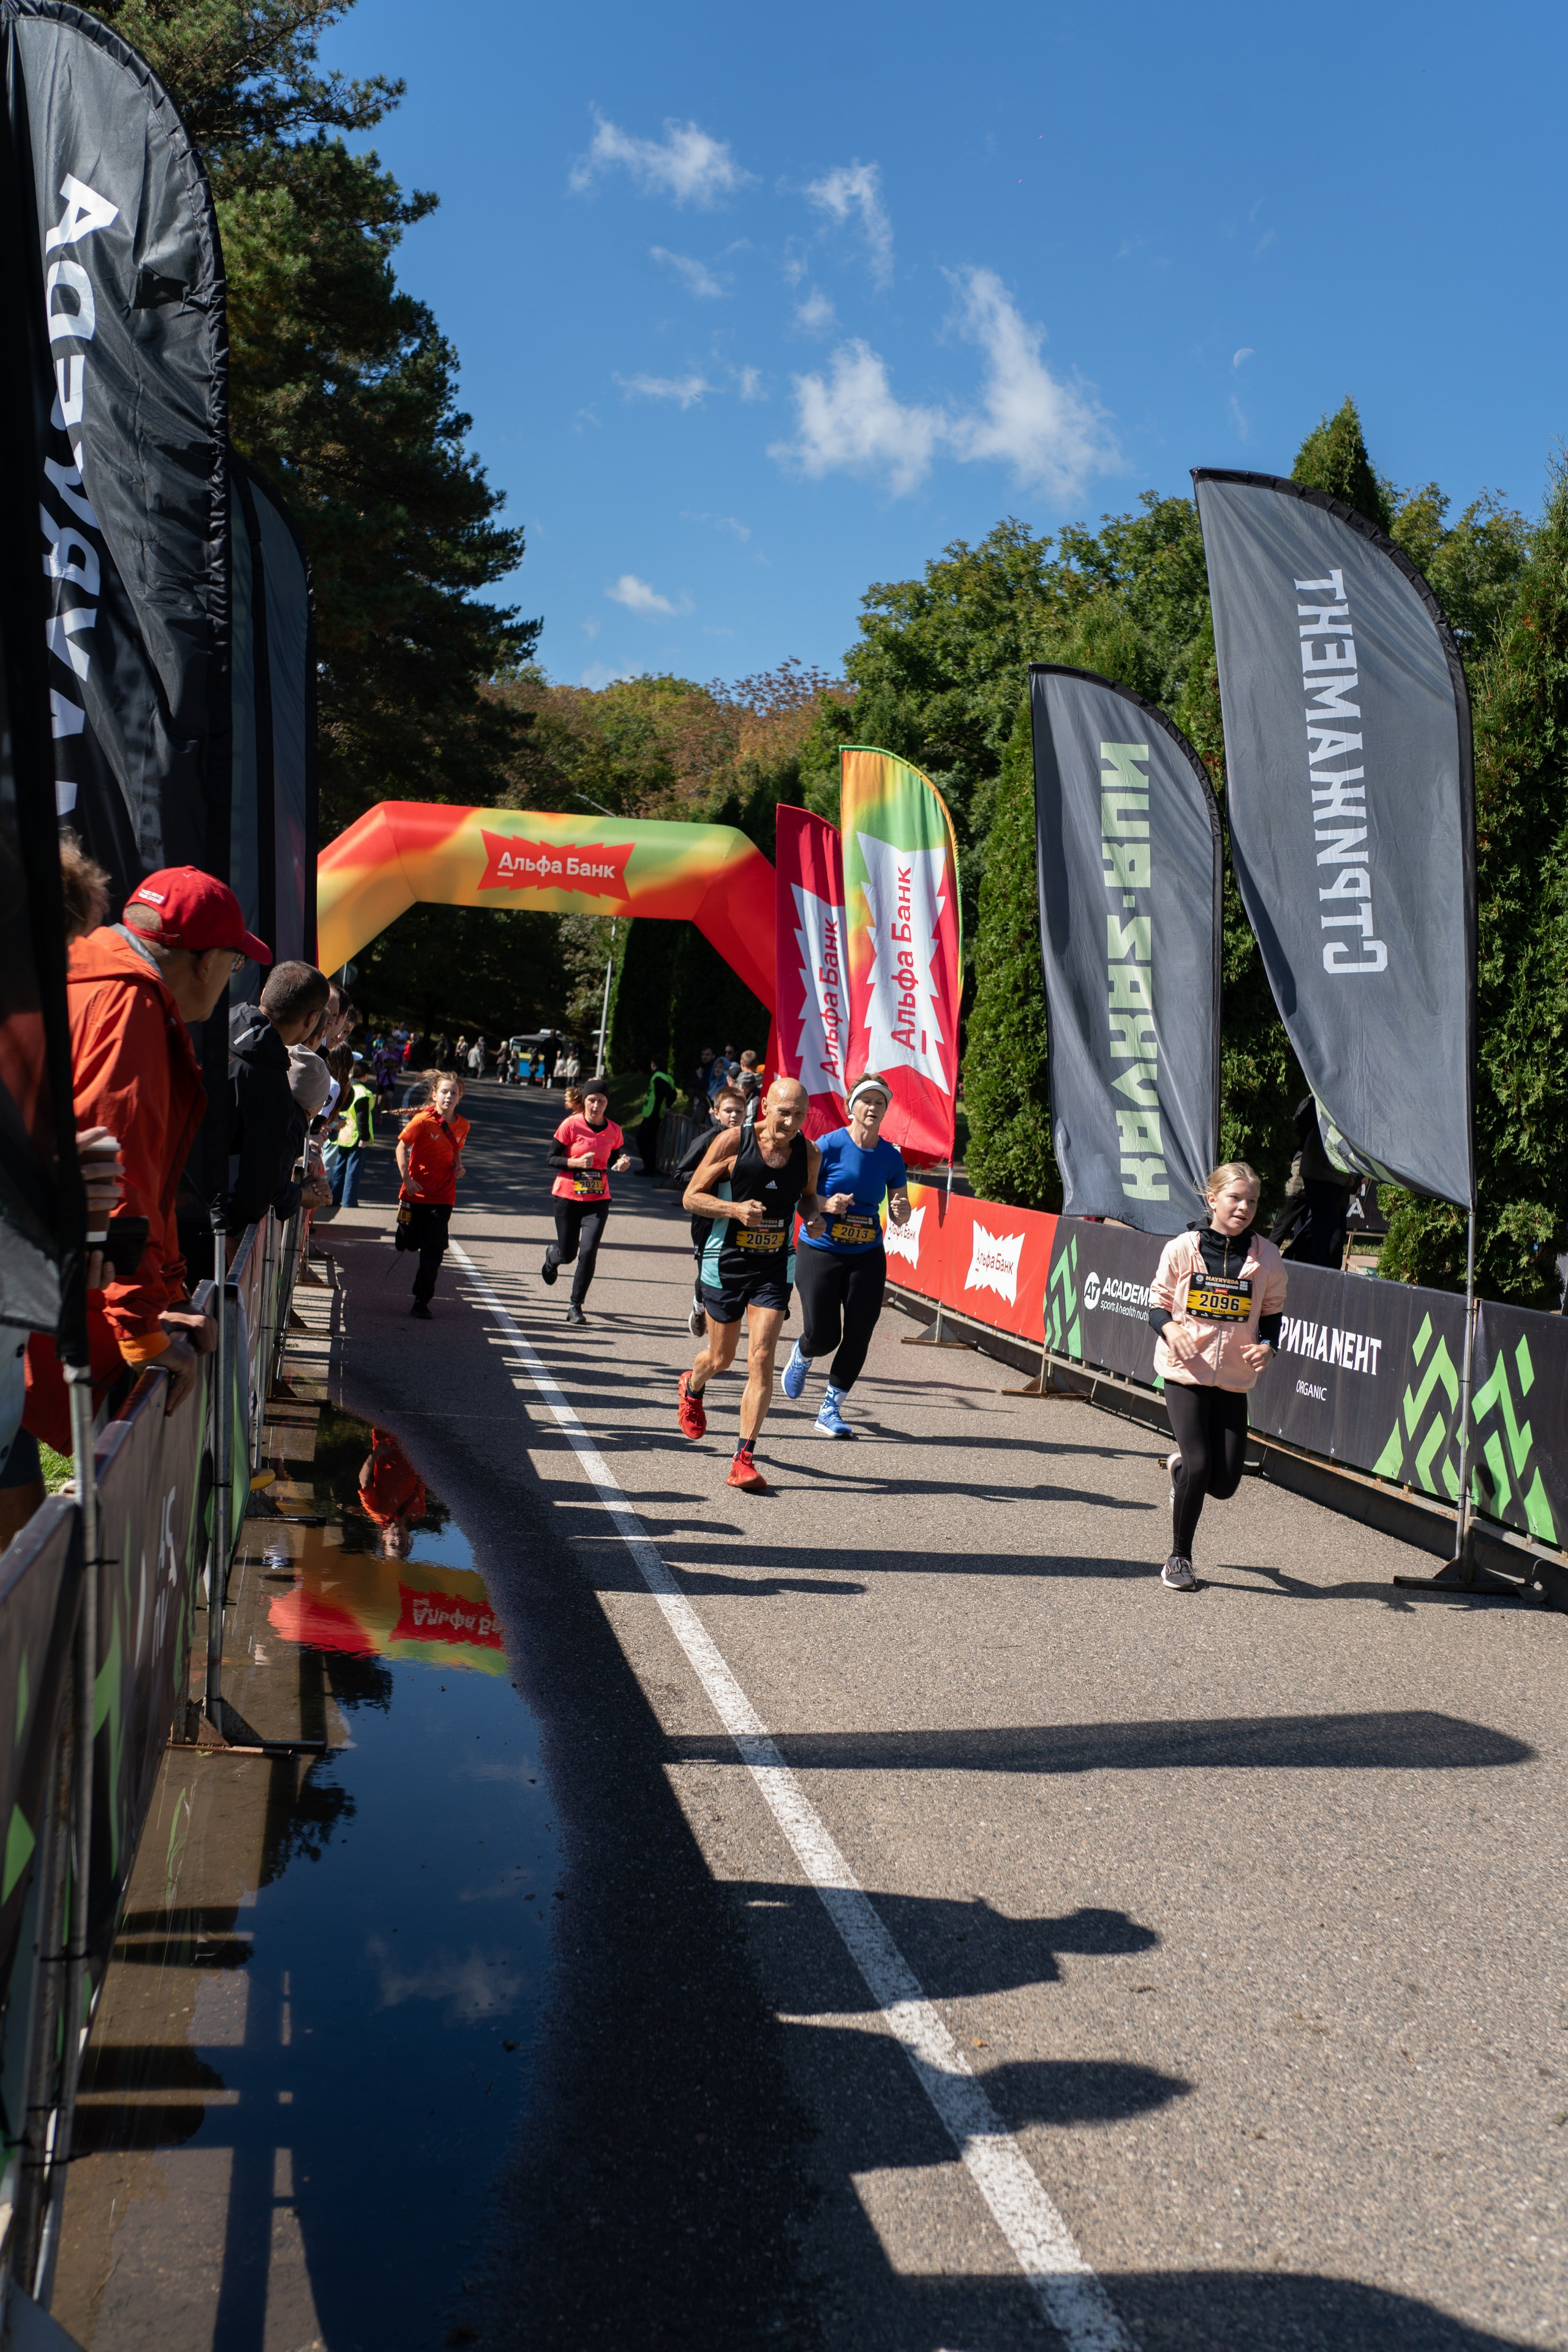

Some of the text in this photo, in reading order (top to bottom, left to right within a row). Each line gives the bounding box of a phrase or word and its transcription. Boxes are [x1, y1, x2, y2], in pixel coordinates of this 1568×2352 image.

[497, 851, 616, 878] Альфа Банк
[891, 866, 926, 1054] Альфа Банк
[819, 915, 842, 1080] Альфа Банк
[746, 1234, 778, 1245] 2052
[840, 1227, 869, 1239] 2013
[976, 1247, 1014, 1275] Альфа Банк
[1102, 1277, 1152, 1308] ACADEM
[1199, 1294, 1240, 1311] 2096
[1100, 1300, 1115, 1312] sports
[1119, 1303, 1136, 1318] health
[1278, 1316, 1382, 1375] РИЖАМЕНТ
[1296, 1379, 1327, 1401] ORGANIC
